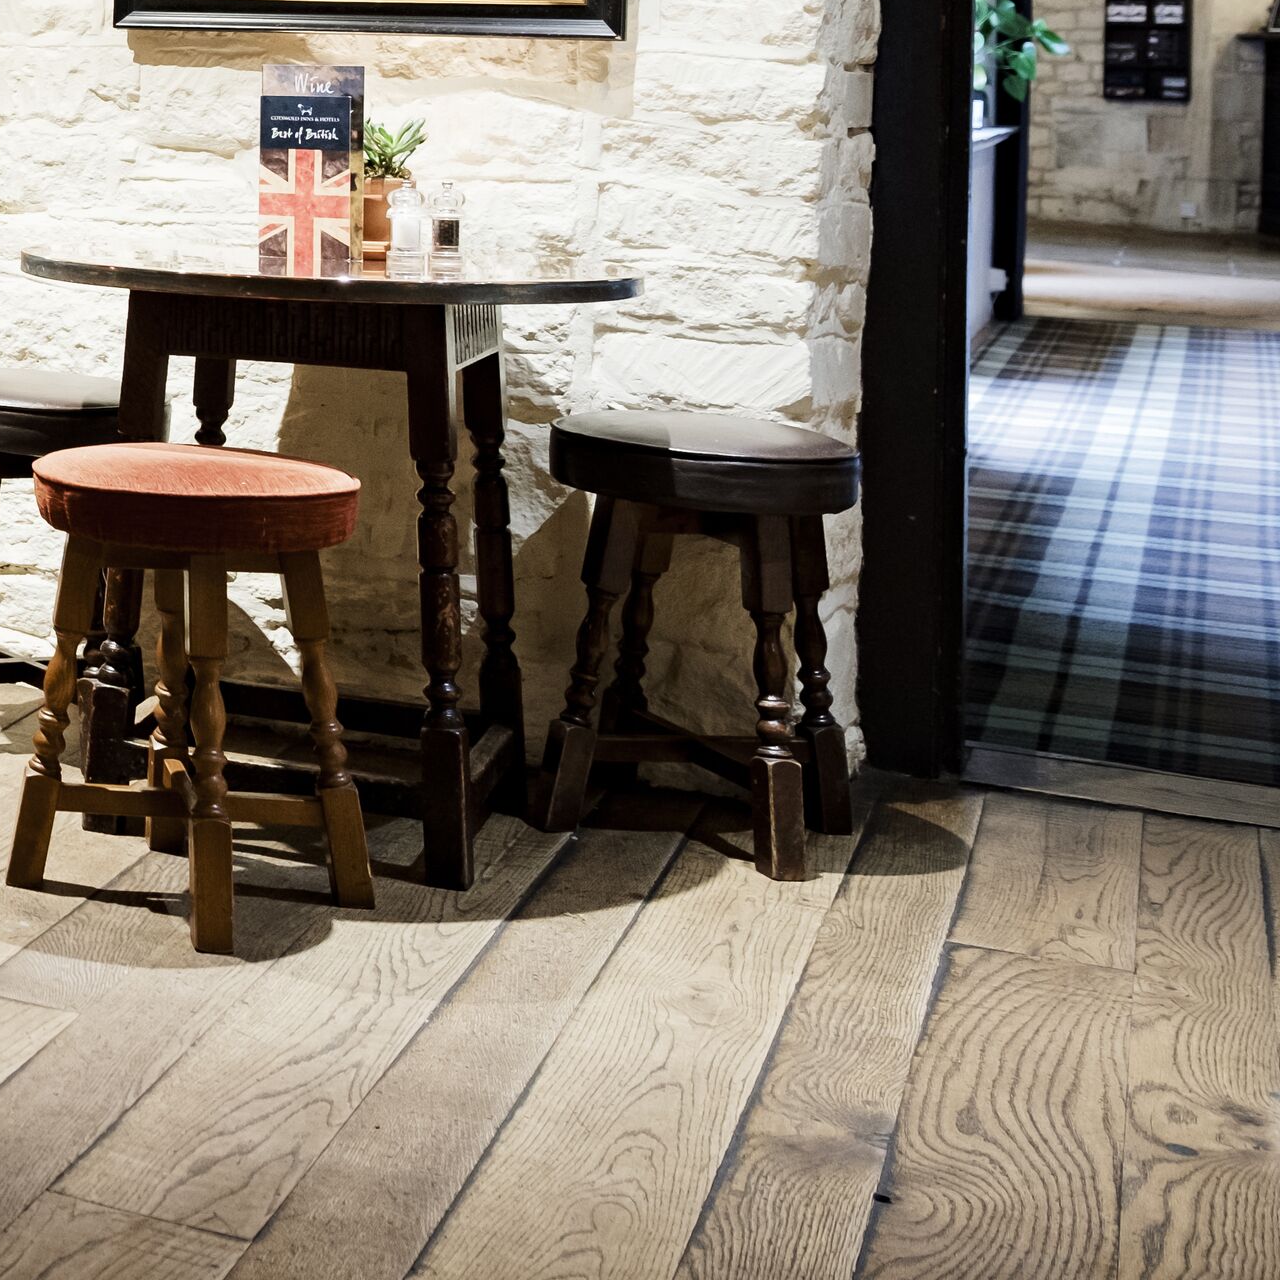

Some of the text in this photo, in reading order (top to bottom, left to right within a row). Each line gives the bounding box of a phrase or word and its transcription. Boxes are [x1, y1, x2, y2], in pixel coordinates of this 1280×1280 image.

[294, 72, 335, 94] Wine
[271, 126, 339, 145] Best of British
